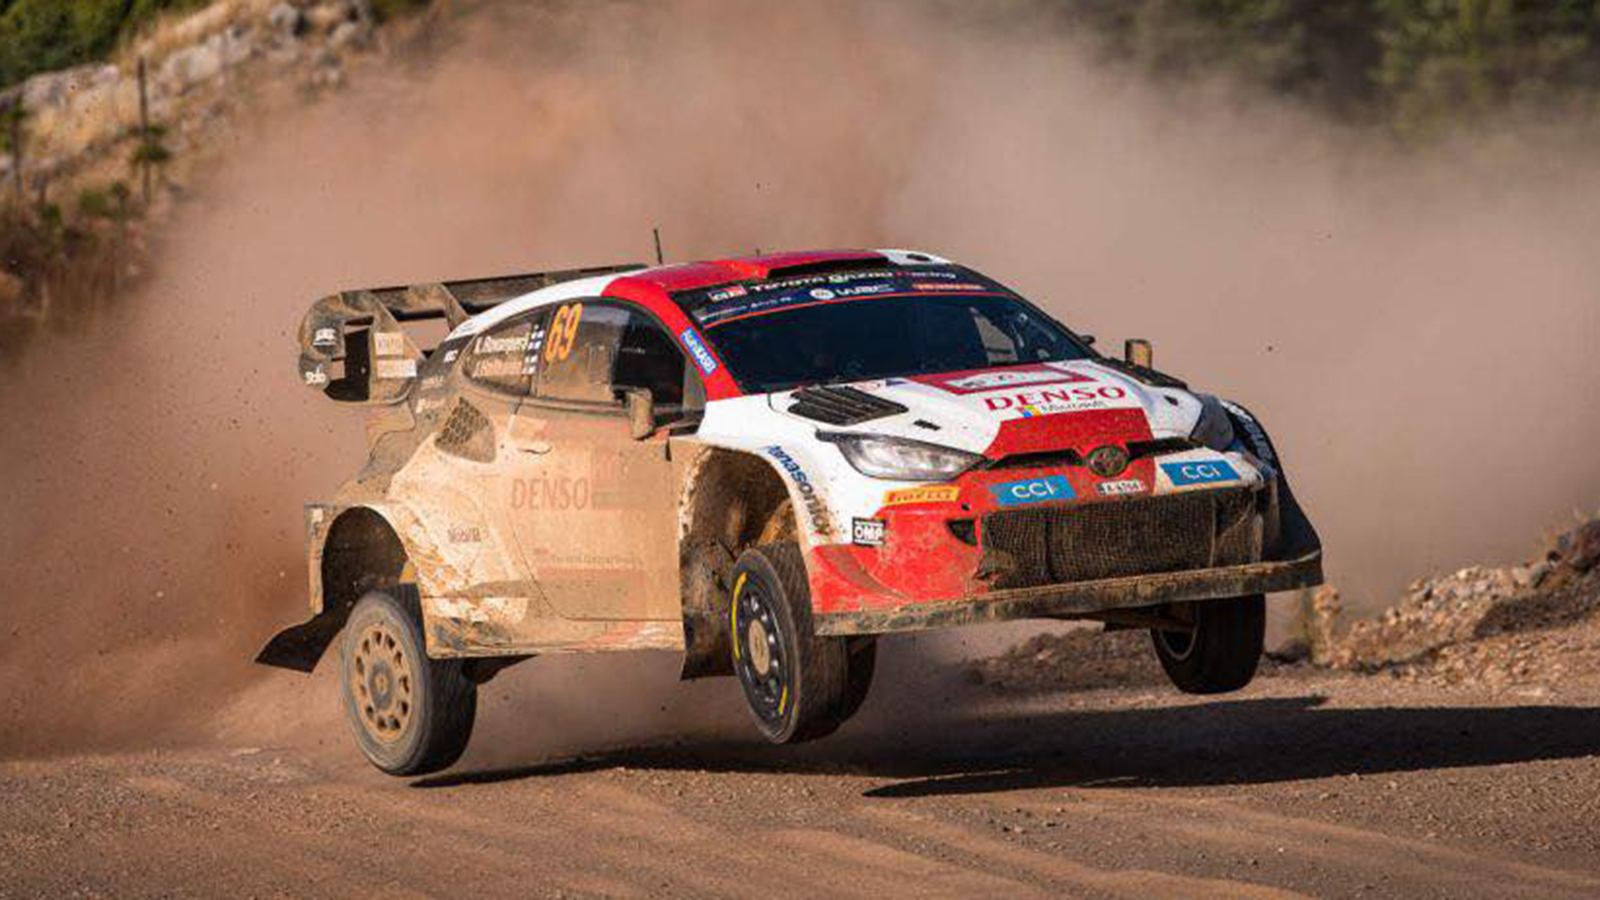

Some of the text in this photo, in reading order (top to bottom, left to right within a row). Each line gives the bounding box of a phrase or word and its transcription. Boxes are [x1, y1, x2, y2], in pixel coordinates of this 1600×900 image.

[543, 303, 583, 363] 69
[984, 386, 1126, 411] DENSO
[510, 479, 589, 510] DENSO
[855, 526, 884, 540] OMP
